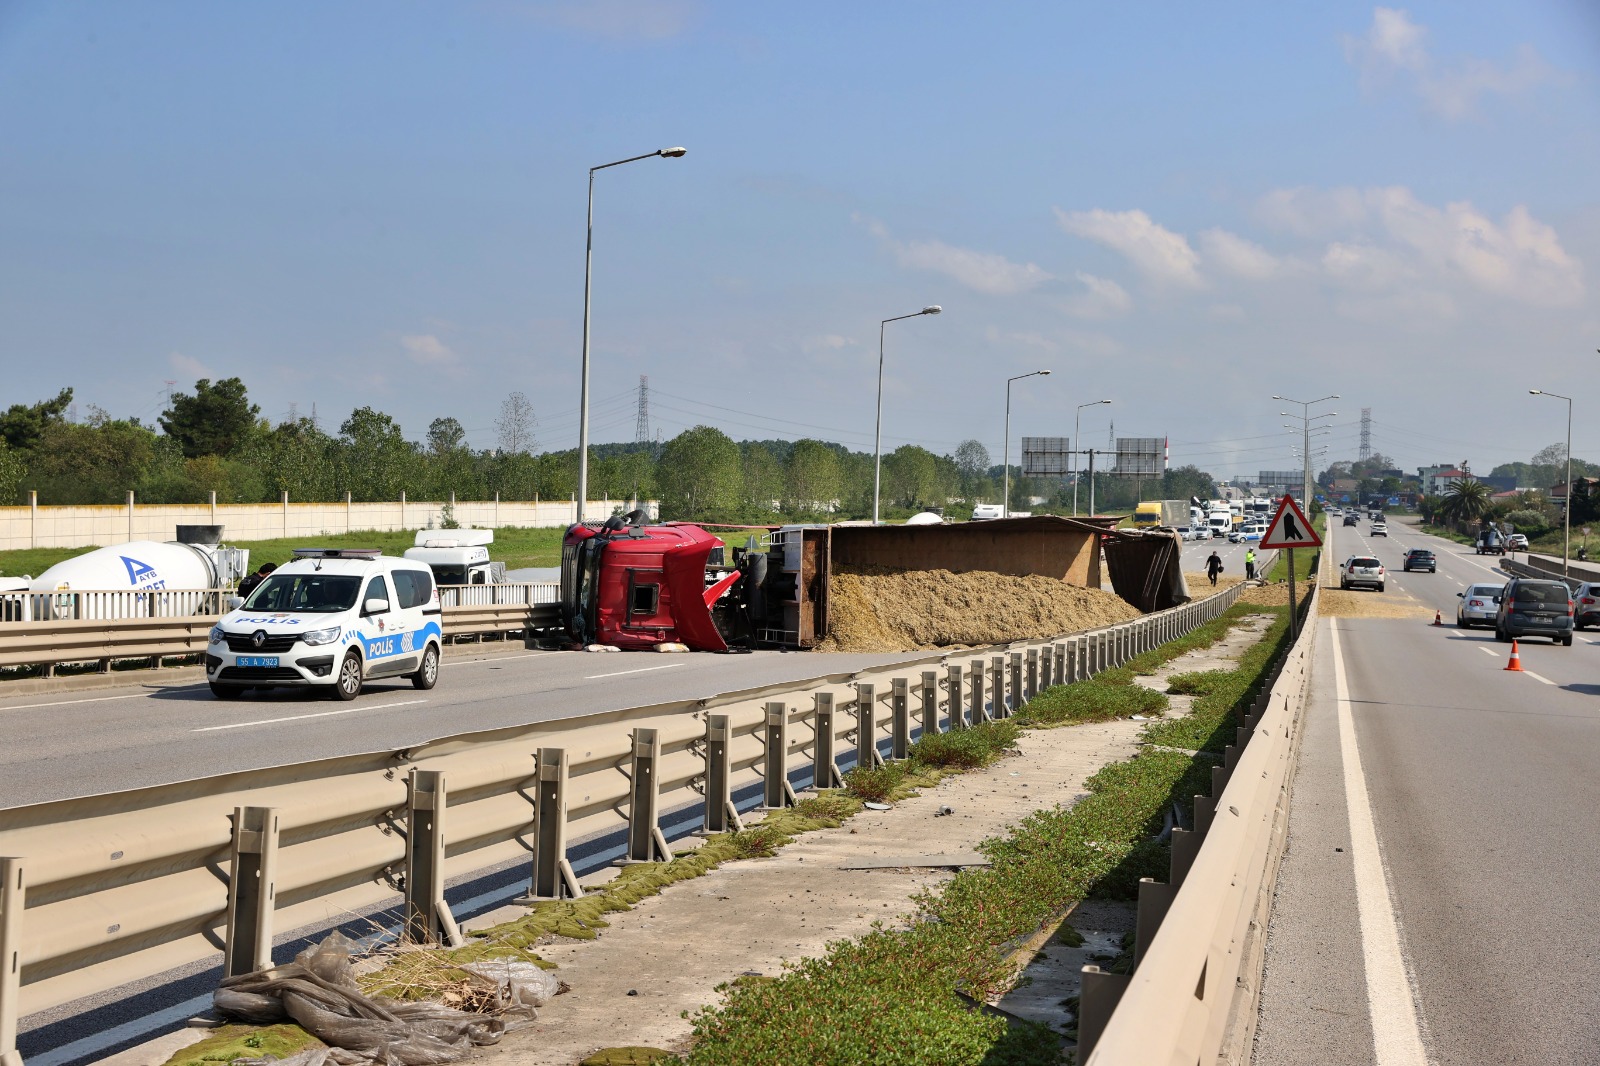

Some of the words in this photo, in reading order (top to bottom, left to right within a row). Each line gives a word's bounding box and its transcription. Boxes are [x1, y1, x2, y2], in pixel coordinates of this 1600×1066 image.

[139, 571, 157, 582] AYB
[137, 580, 166, 602] AET
[369, 637, 394, 657] POLİS
[240, 657, 249, 666] 55
[253, 657, 258, 666] A
[262, 657, 278, 666] 7923
